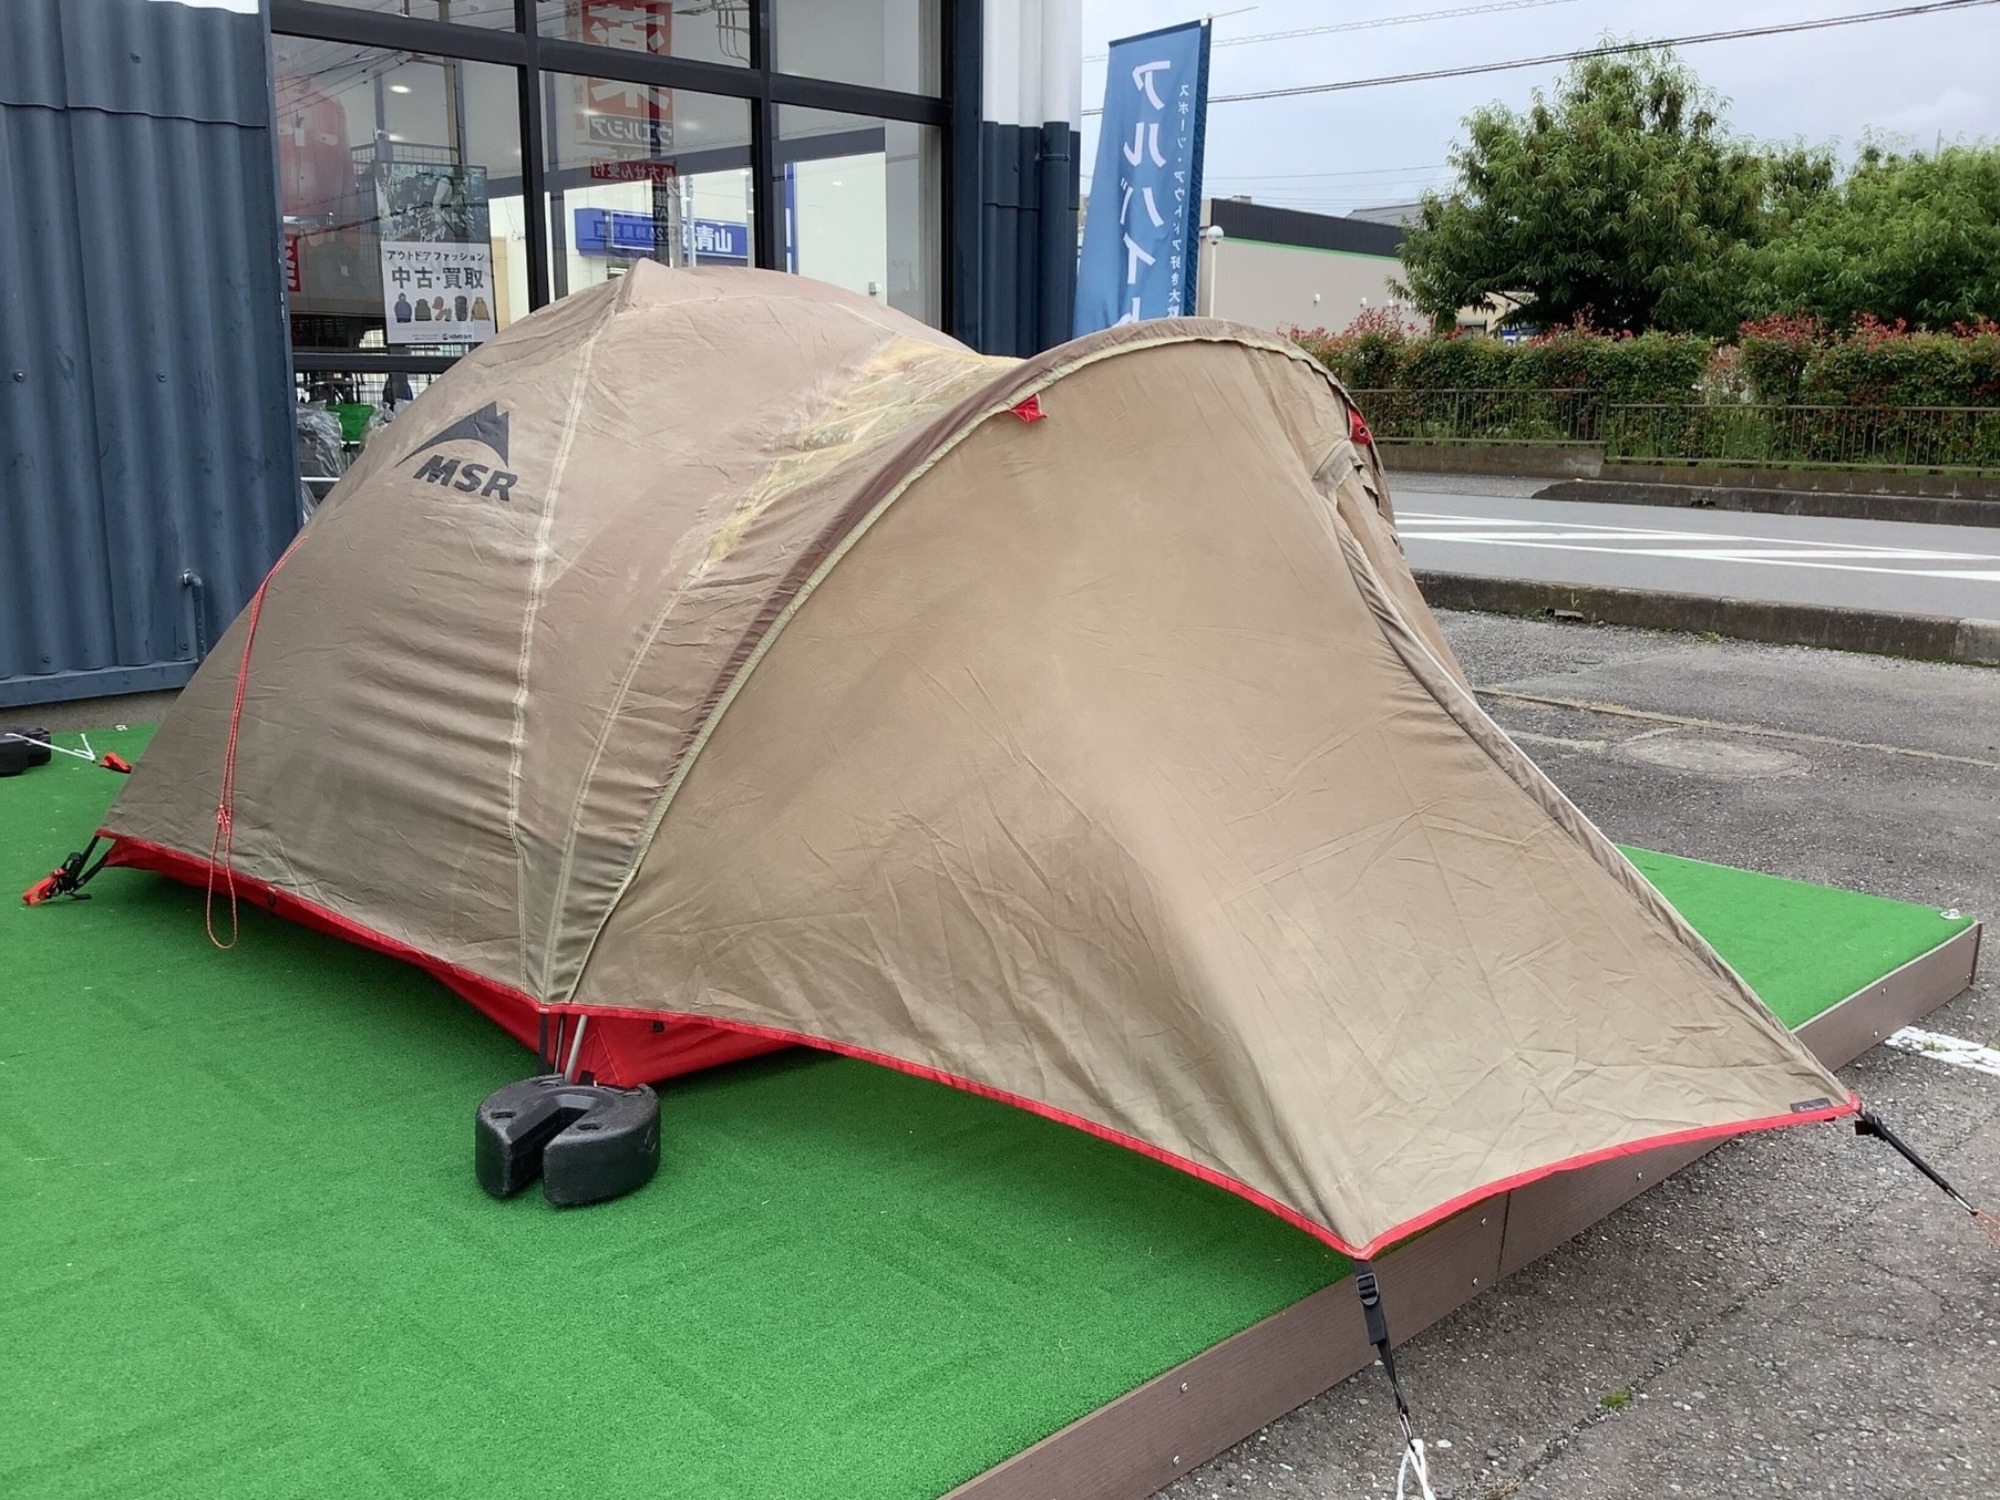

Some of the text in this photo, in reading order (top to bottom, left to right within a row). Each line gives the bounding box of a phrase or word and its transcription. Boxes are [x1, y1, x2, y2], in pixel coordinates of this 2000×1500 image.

[387, 250, 485, 261] アウトドアファッション
[391, 266, 484, 289] 中古・買取
[412, 454, 518, 502] MSR
